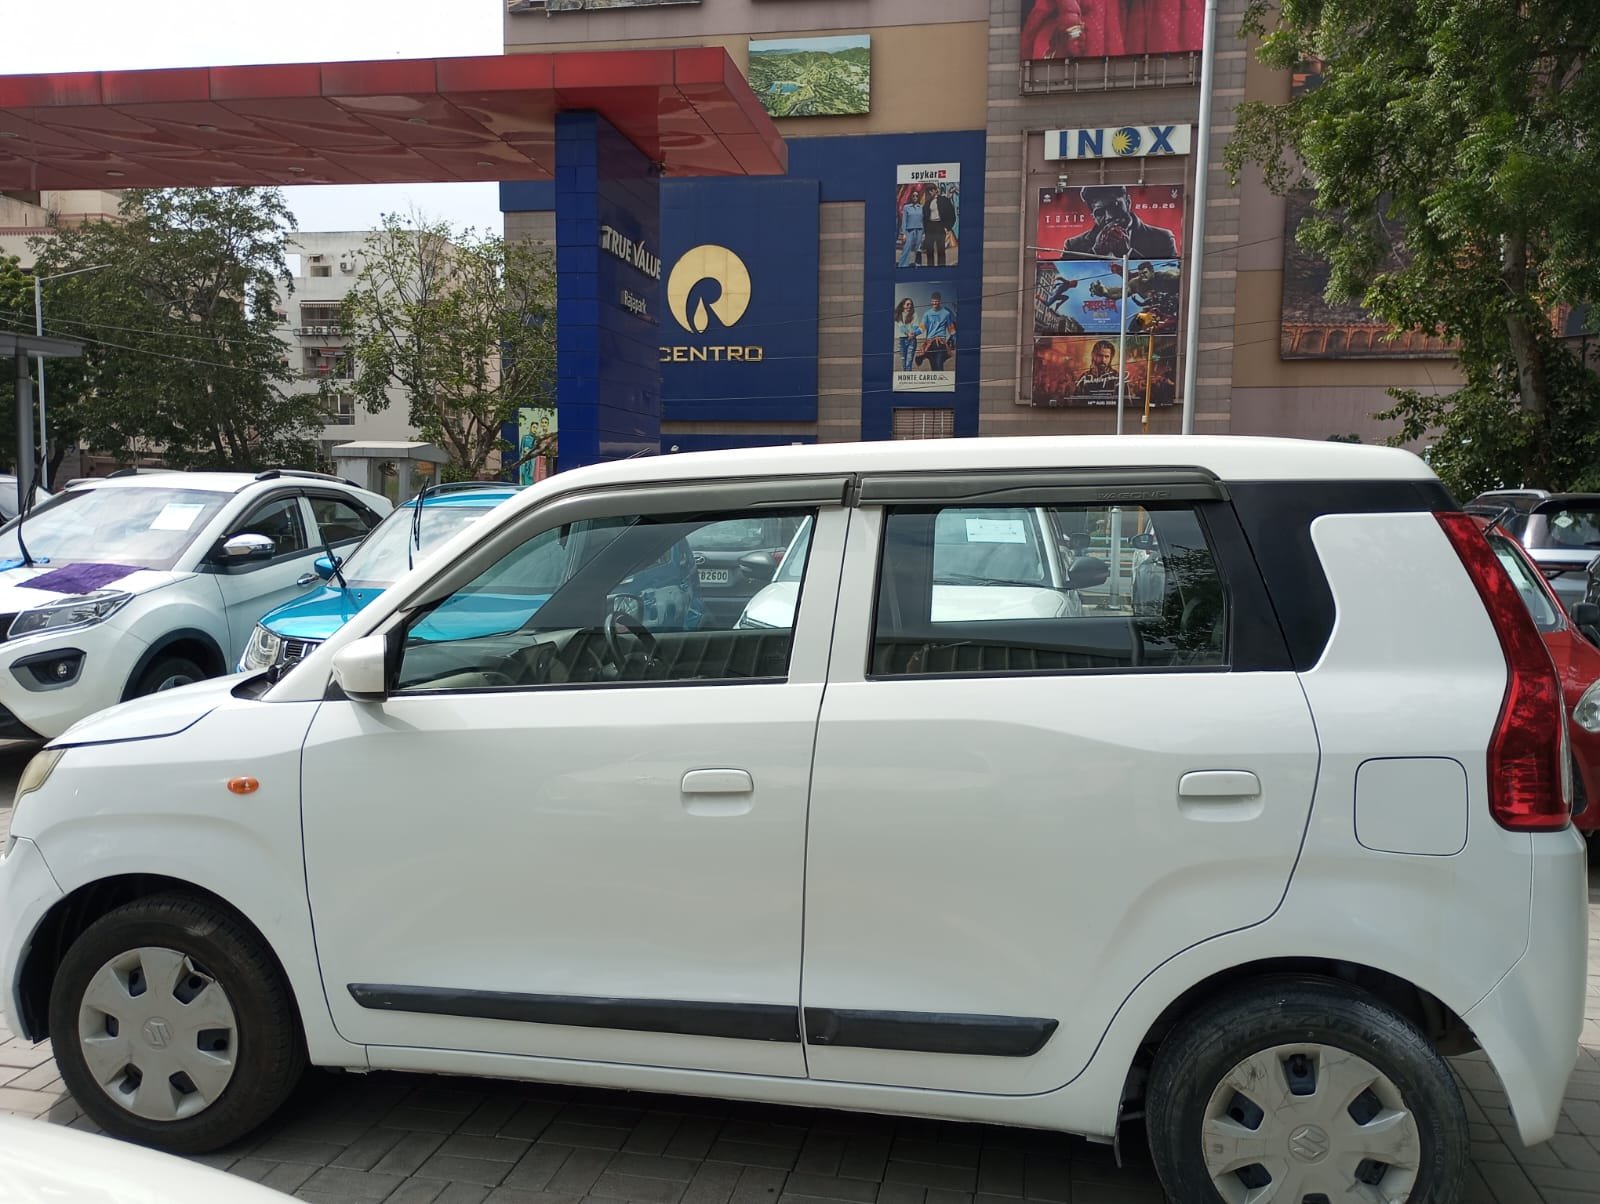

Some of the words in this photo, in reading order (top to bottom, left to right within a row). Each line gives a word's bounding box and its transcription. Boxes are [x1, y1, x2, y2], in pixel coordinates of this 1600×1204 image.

[1058, 125, 1176, 157] INOX
[911, 170, 938, 180] spykar
[601, 225, 632, 263] TRUE
[632, 240, 662, 280] VALUE
[658, 346, 763, 362] CENTRO
